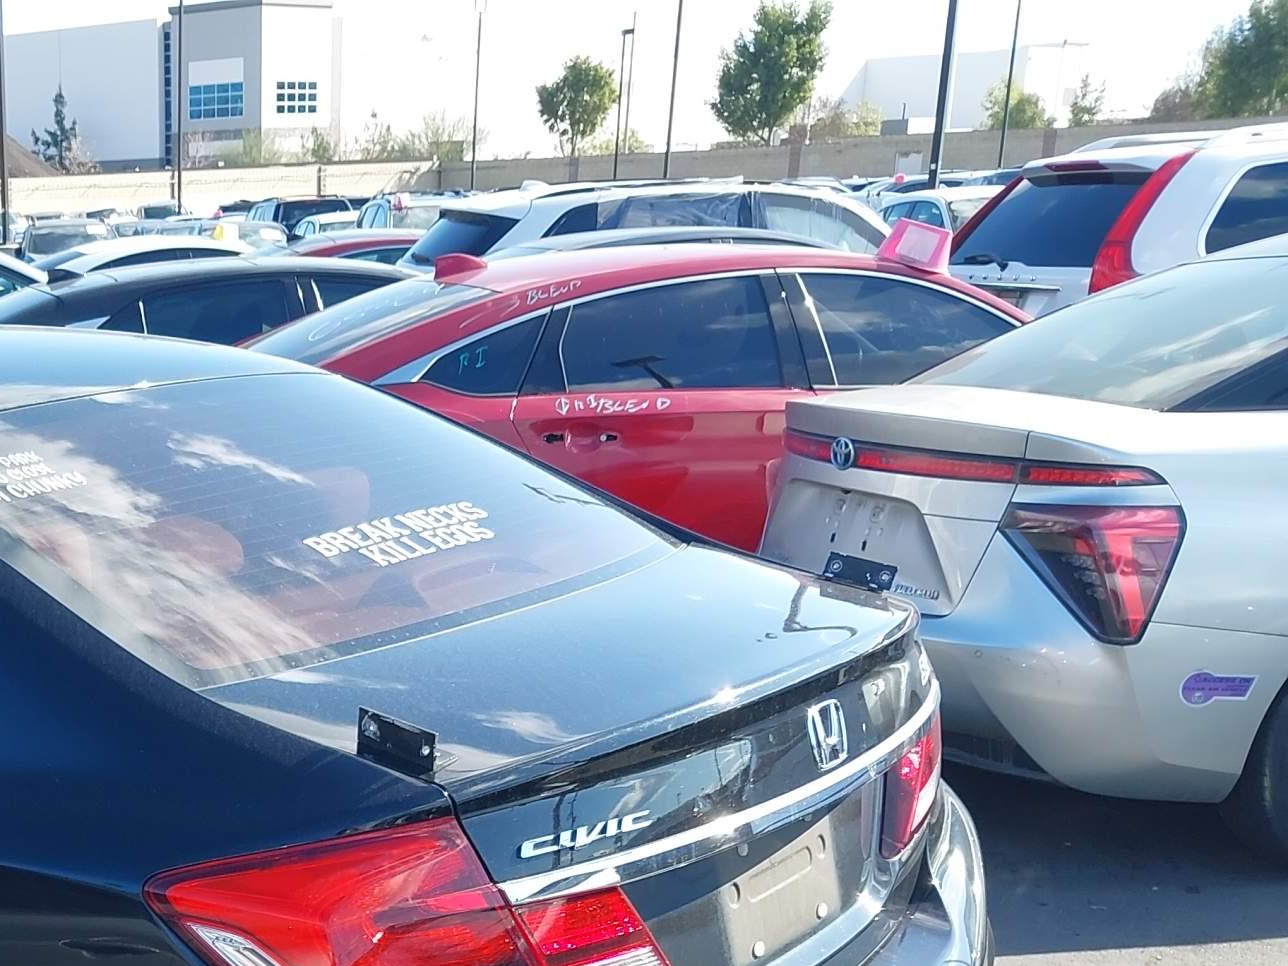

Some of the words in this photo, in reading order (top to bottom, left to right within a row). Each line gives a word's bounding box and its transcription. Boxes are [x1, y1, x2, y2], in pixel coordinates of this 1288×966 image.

[6, 471, 88, 498] CHUNKY
[303, 516, 411, 559] BREAK
[394, 500, 489, 533] NECKS
[358, 535, 437, 568] KILL
[419, 521, 496, 551] EGOS
[520, 809, 655, 859] CIVIC
